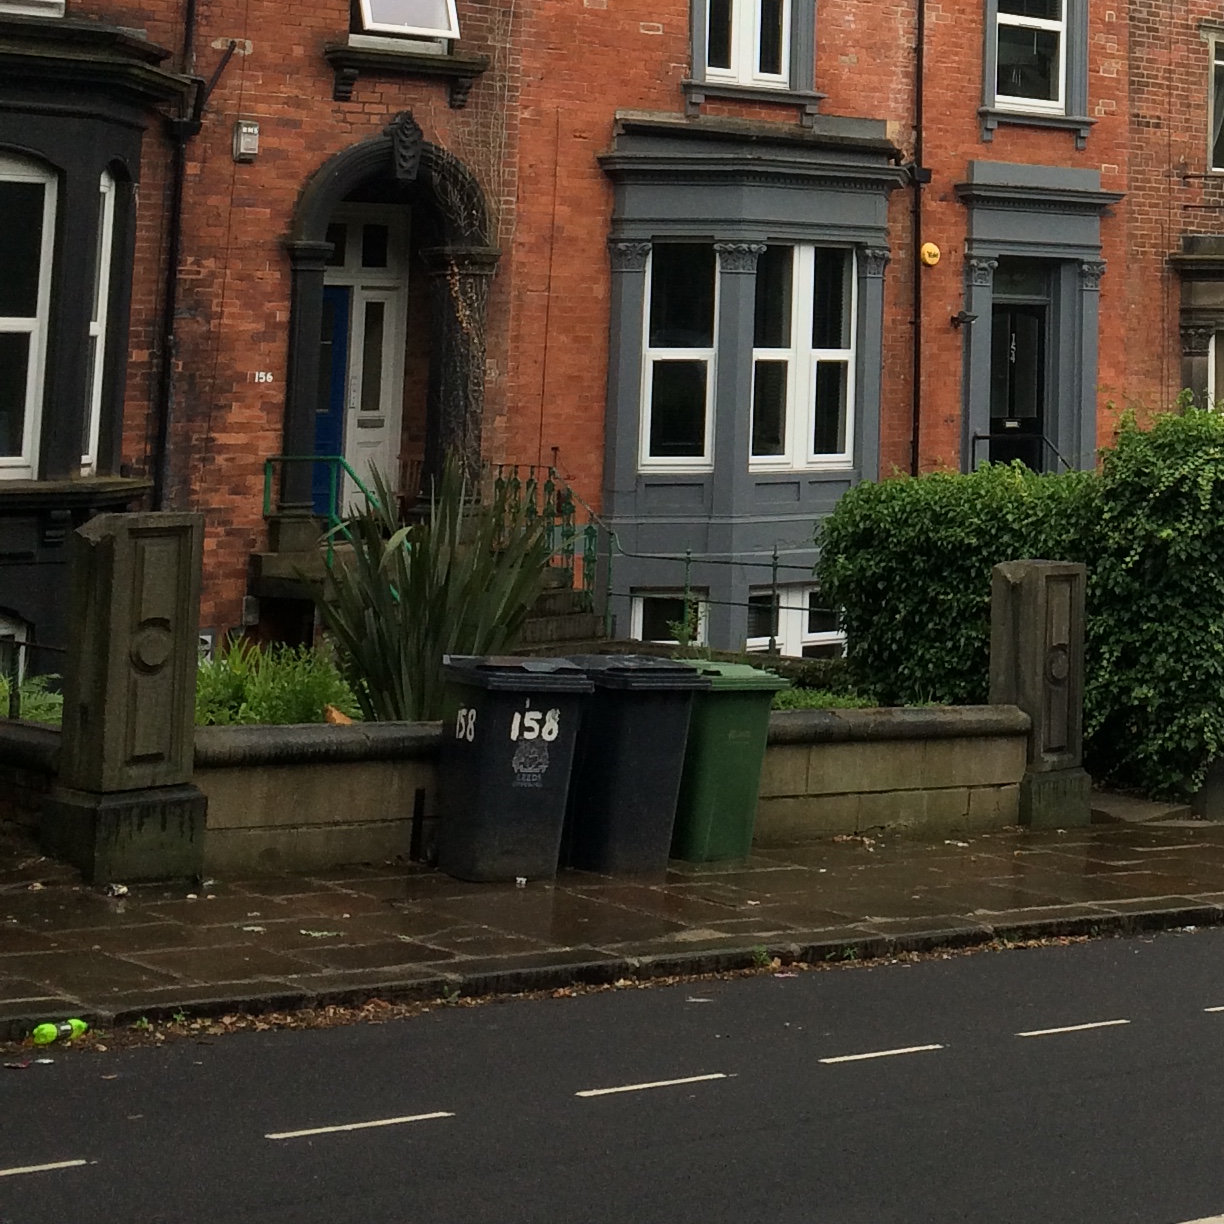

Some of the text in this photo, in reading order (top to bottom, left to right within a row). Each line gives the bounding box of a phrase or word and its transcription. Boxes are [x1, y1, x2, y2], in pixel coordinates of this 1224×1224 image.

[254, 371, 274, 383] 156
[455, 708, 477, 742] 158
[510, 708, 560, 741] 158
